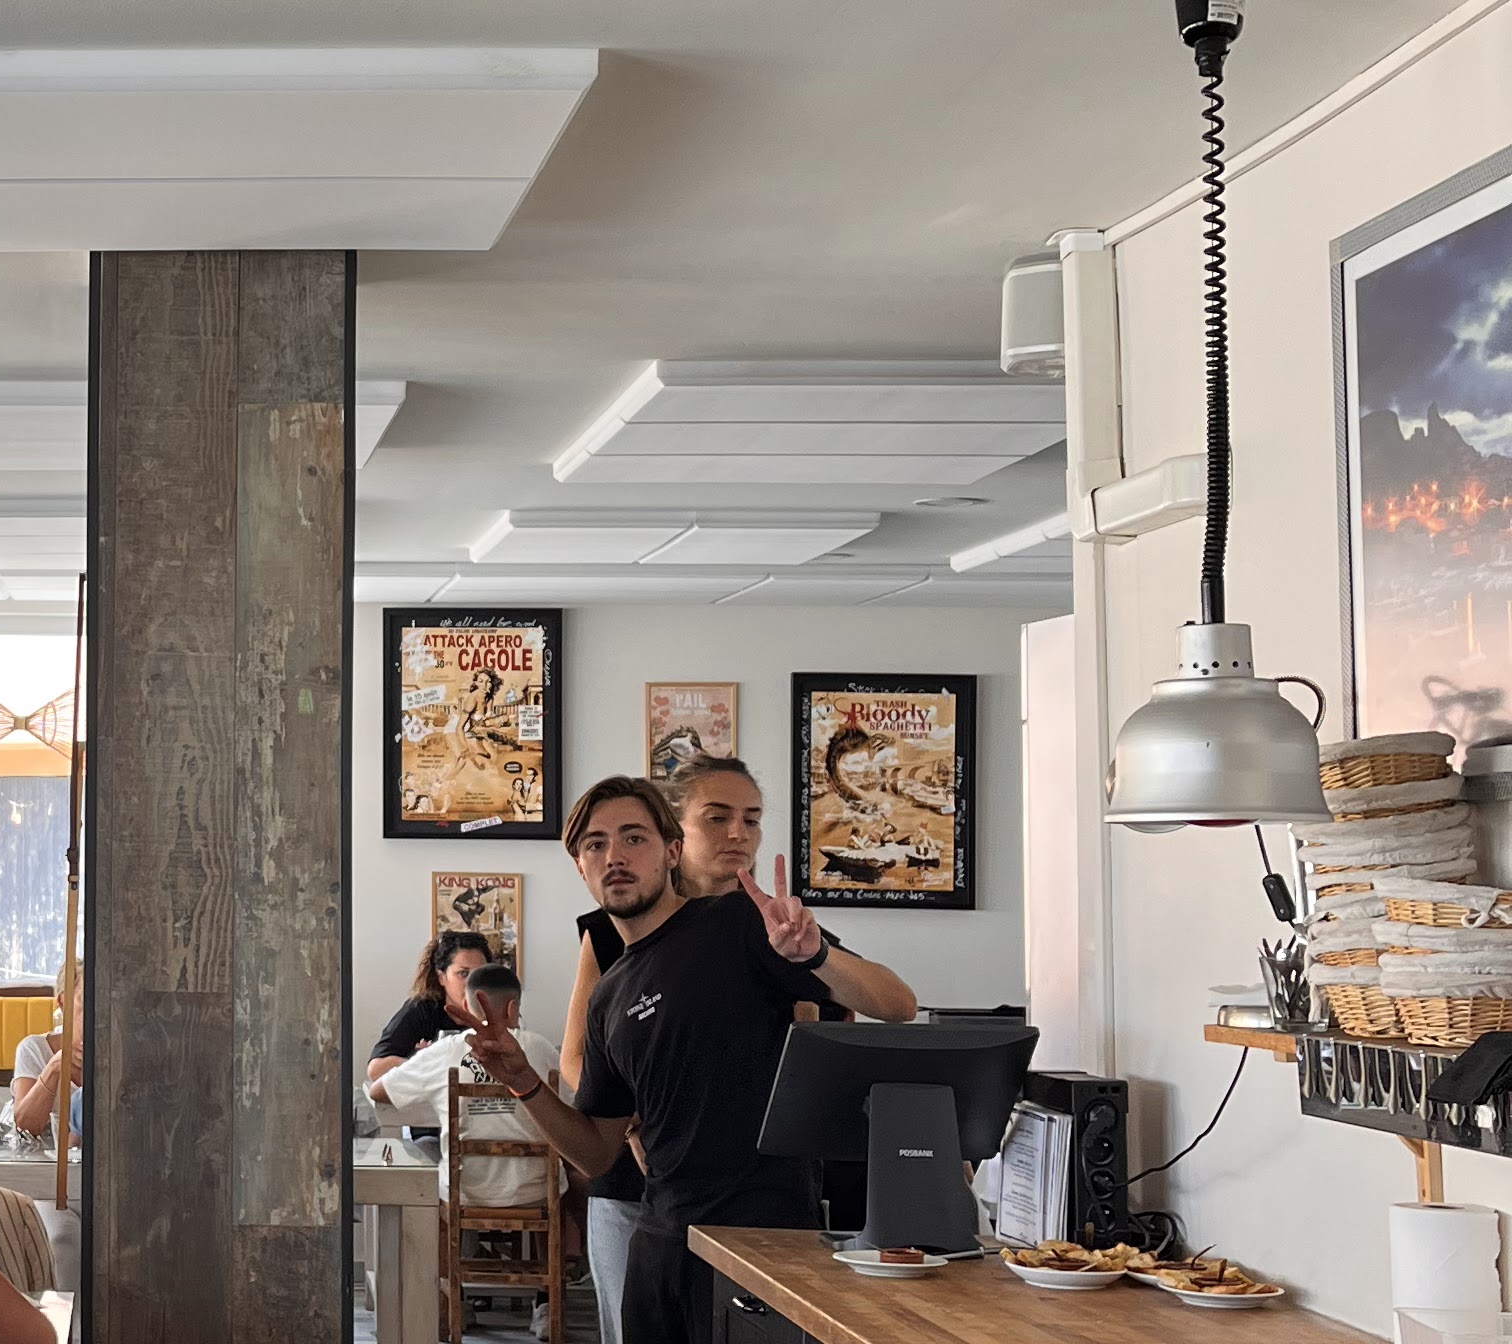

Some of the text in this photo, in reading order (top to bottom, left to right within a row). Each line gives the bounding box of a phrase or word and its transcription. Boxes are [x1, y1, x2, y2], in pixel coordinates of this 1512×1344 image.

[423, 634, 523, 648] ATTACK APERO
[457, 648, 533, 672] CAGOLE
[873, 699, 908, 709] TRASH
[851, 701, 931, 731] Bloody
[438, 876, 516, 889] KING KONG
